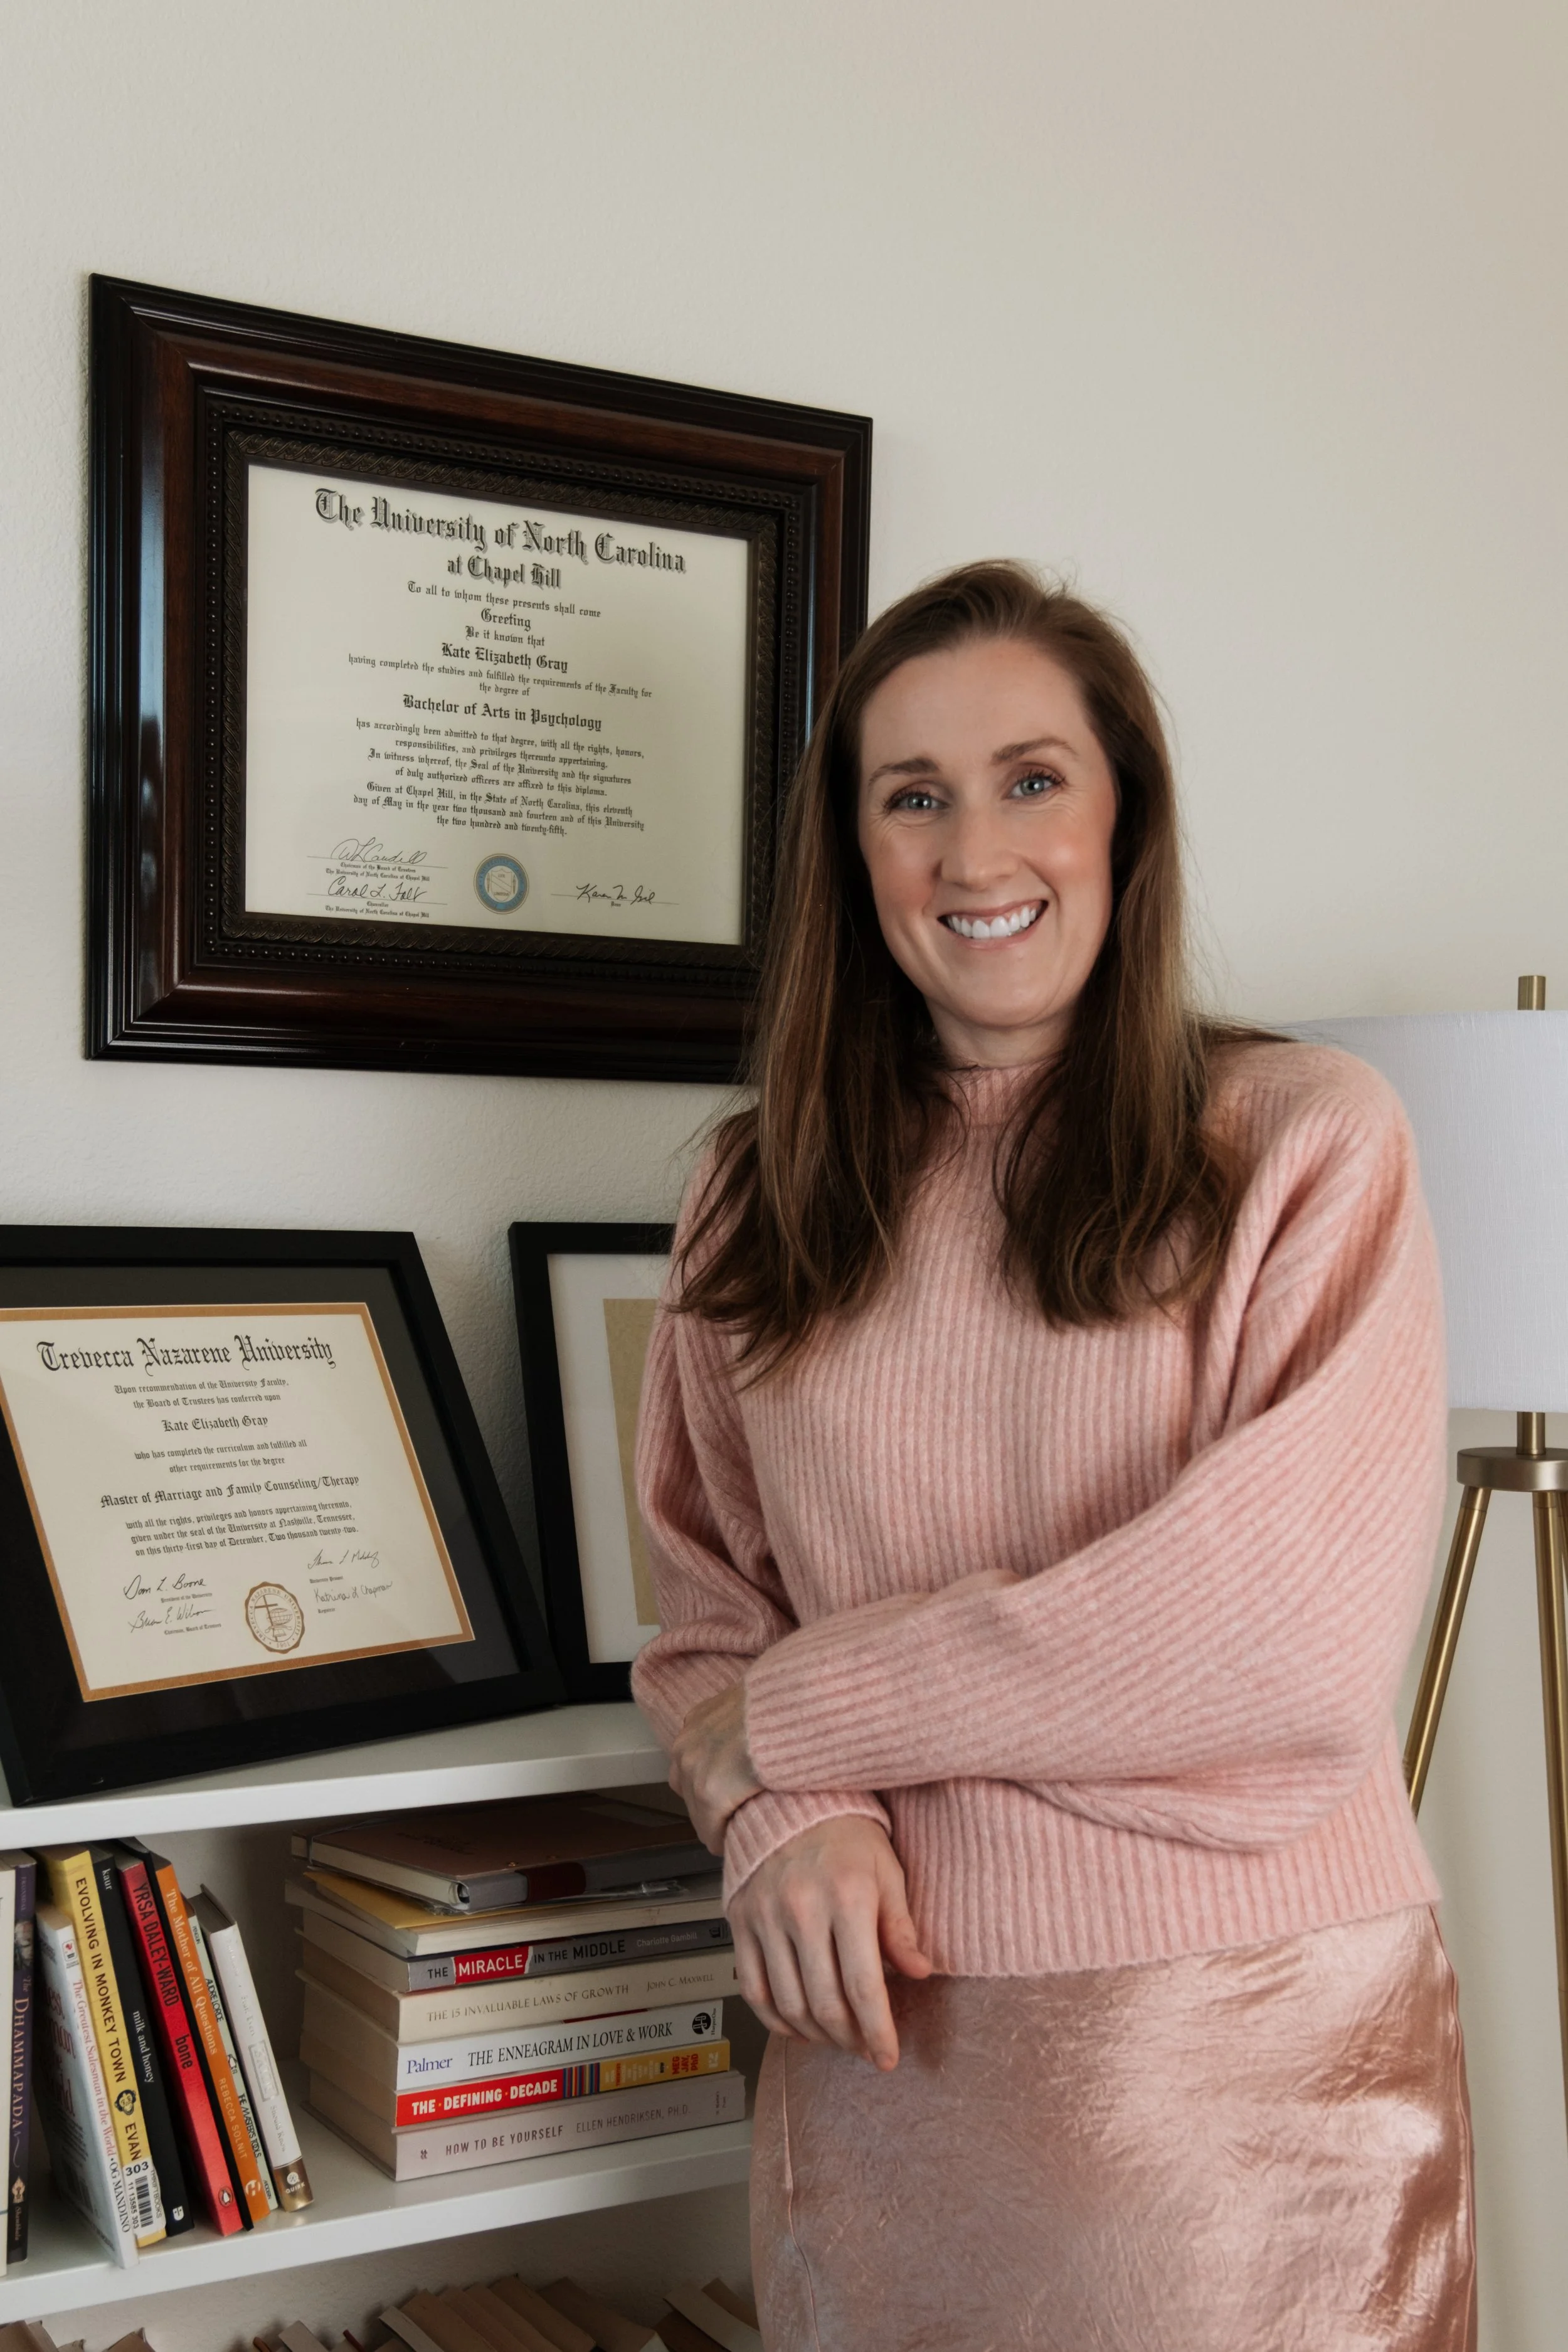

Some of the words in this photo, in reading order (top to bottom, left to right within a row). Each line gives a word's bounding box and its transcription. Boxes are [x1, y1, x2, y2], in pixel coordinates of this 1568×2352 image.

[315, 487, 363, 530] The
[369, 496, 487, 553] University
[494, 522, 519, 549] of
[522, 520, 588, 565] North
[594, 532, 686, 573] Carolina
[447, 554, 462, 575] at
[467, 555, 525, 588] Chapel
[530, 563, 561, 590] Hill
[407, 580, 421, 593] To
[425, 585, 437, 595] all
[441, 586, 450, 596] to
[454, 589, 481, 602] whom
[485, 592, 509, 606] these
[512, 600, 549, 610] presents
[554, 601, 575, 615] shall
[579, 609, 601, 617] come
[480, 608, 531, 632] Greeting
[465, 625, 479, 640] Be
[483, 630, 490, 639] it
[494, 630, 523, 644] known
[527, 635, 544, 649] that
[442, 642, 470, 659] Kate
[475, 647, 531, 669] Elizabeth
[536, 655, 568, 673] Gray
[403, 694, 459, 714] Bachelor
[464, 702, 477, 715] of
[481, 703, 509, 718] Arts
[514, 708, 526, 721] in
[531, 708, 601, 731] Psychology
[437, 815, 448, 827] the
[452, 817, 466, 825] two
[470, 817, 501, 829] hundred
[504, 822, 517, 830] and
[521, 823, 567, 837] twenty-fifth.
[36, 1341, 134, 1371] Trevecca
[136, 1337, 231, 1376] Nazarene
[234, 1335, 336, 1370] University
[114, 1385, 137, 1394] Upon
[138, 1383, 197, 1392] recommendation
[198, 1381, 206, 1389] of
[218, 1380, 257, 1388] University
[260, 1378, 289, 1387] Faculty,
[133, 1400, 144, 1408] the
[146, 1399, 171, 1407] Board
[172, 1397, 179, 1406] of
[181, 1397, 215, 1406] Trustees
[231, 1394, 262, 1402] conferred
[161, 1419, 188, 1432] Kate
[191, 1416, 240, 1429] Elizabeth
[241, 1415, 268, 1426] Gray
[100, 1495, 138, 1508] Master
[141, 1491, 151, 1503] of
[154, 1490, 202, 1503] Marriage
[205, 1486, 223, 1496] and
[226, 1482, 261, 1497] Family
[264, 1476, 359, 1491] Counseling/Therapy
[102, 1868, 112, 1889] kaur
[75, 1877, 98, 1949] EVOLVING
[166, 1888, 177, 1914] The
[133, 1882, 152, 1920] YRSA
[143, 1921, 179, 2007] DALEY-WARD
[172, 1915, 190, 1957] Mother
[91, 1953, 103, 1969] IN
[185, 1961, 197, 1972] of
[427, 1966, 448, 1979] THE
[458, 1954, 523, 1976] MIRACLE
[534, 1953, 544, 1963] IN
[548, 1949, 567, 1961] THE
[573, 1939, 625, 1959] MIDDLE
[636, 1937, 669, 1947] Charlotte
[670, 1932, 697, 1942] Gambill
[23, 1975, 31, 1992] The
[73, 1980, 83, 1998] The
[189, 1976, 203, 1994] All
[668, 1978, 676, 1986] C.
[95, 1973, 117, 2032] MONKEY
[429, 2010, 447, 2021] THE
[452, 2008, 460, 2018] 15
[465, 1998, 529, 2016] INVALUABLE
[533, 1994, 561, 2006] LAWS
[564, 1991, 577, 2001] OF
[581, 1984, 628, 1999] GROWTH
[77, 2001, 92, 2043] Greatest
[132, 2011, 145, 2033] milk
[194, 1996, 216, 2055] Questions
[137, 2035, 150, 2053] and
[176, 2033, 193, 2070] bone
[468, 2049, 492, 2067] THE
[498, 2037, 573, 2062] ENNEAGRAM
[576, 2035, 590, 2050] IN
[593, 2030, 623, 2047] LOVE
[627, 2028, 634, 2042] &
[638, 2022, 672, 2039] WORK
[12, 1997, 29, 2129] DHAMMAPADA
[86, 2045, 102, 2096] Salesman
[108, 2037, 126, 2082] TOWN
[142, 2053, 154, 2082] honey
[407, 2057, 452, 2074] Palmer
[97, 2097, 105, 2108] in
[411, 2099, 435, 2115] THE
[443, 2088, 502, 2110] DEFINING
[510, 2079, 557, 2099] DECADE
[99, 2110, 109, 2125] the
[219, 2077, 236, 2122] REBECCA
[231, 2124, 247, 2158] SOLNIT
[576, 2119, 603, 2132] ELLEN
[607, 2109, 664, 2127] HENDRIKSEN,
[668, 2105, 690, 2116] PH.D.
[103, 2126, 116, 2156] World
[125, 2122, 141, 2161] EVAN
[446, 2142, 469, 2155] HOW
[474, 2138, 486, 2150] TO
[492, 2135, 504, 2147] BE
[510, 2125, 563, 2144] YOURSELF
[110, 2162, 120, 2179] OG
[125, 2161, 149, 2176] 303
[128, 2182, 134, 2190] 11
[285, 2181, 305, 2193] QUIRK
[113, 2180, 130, 2233] MANDINO
